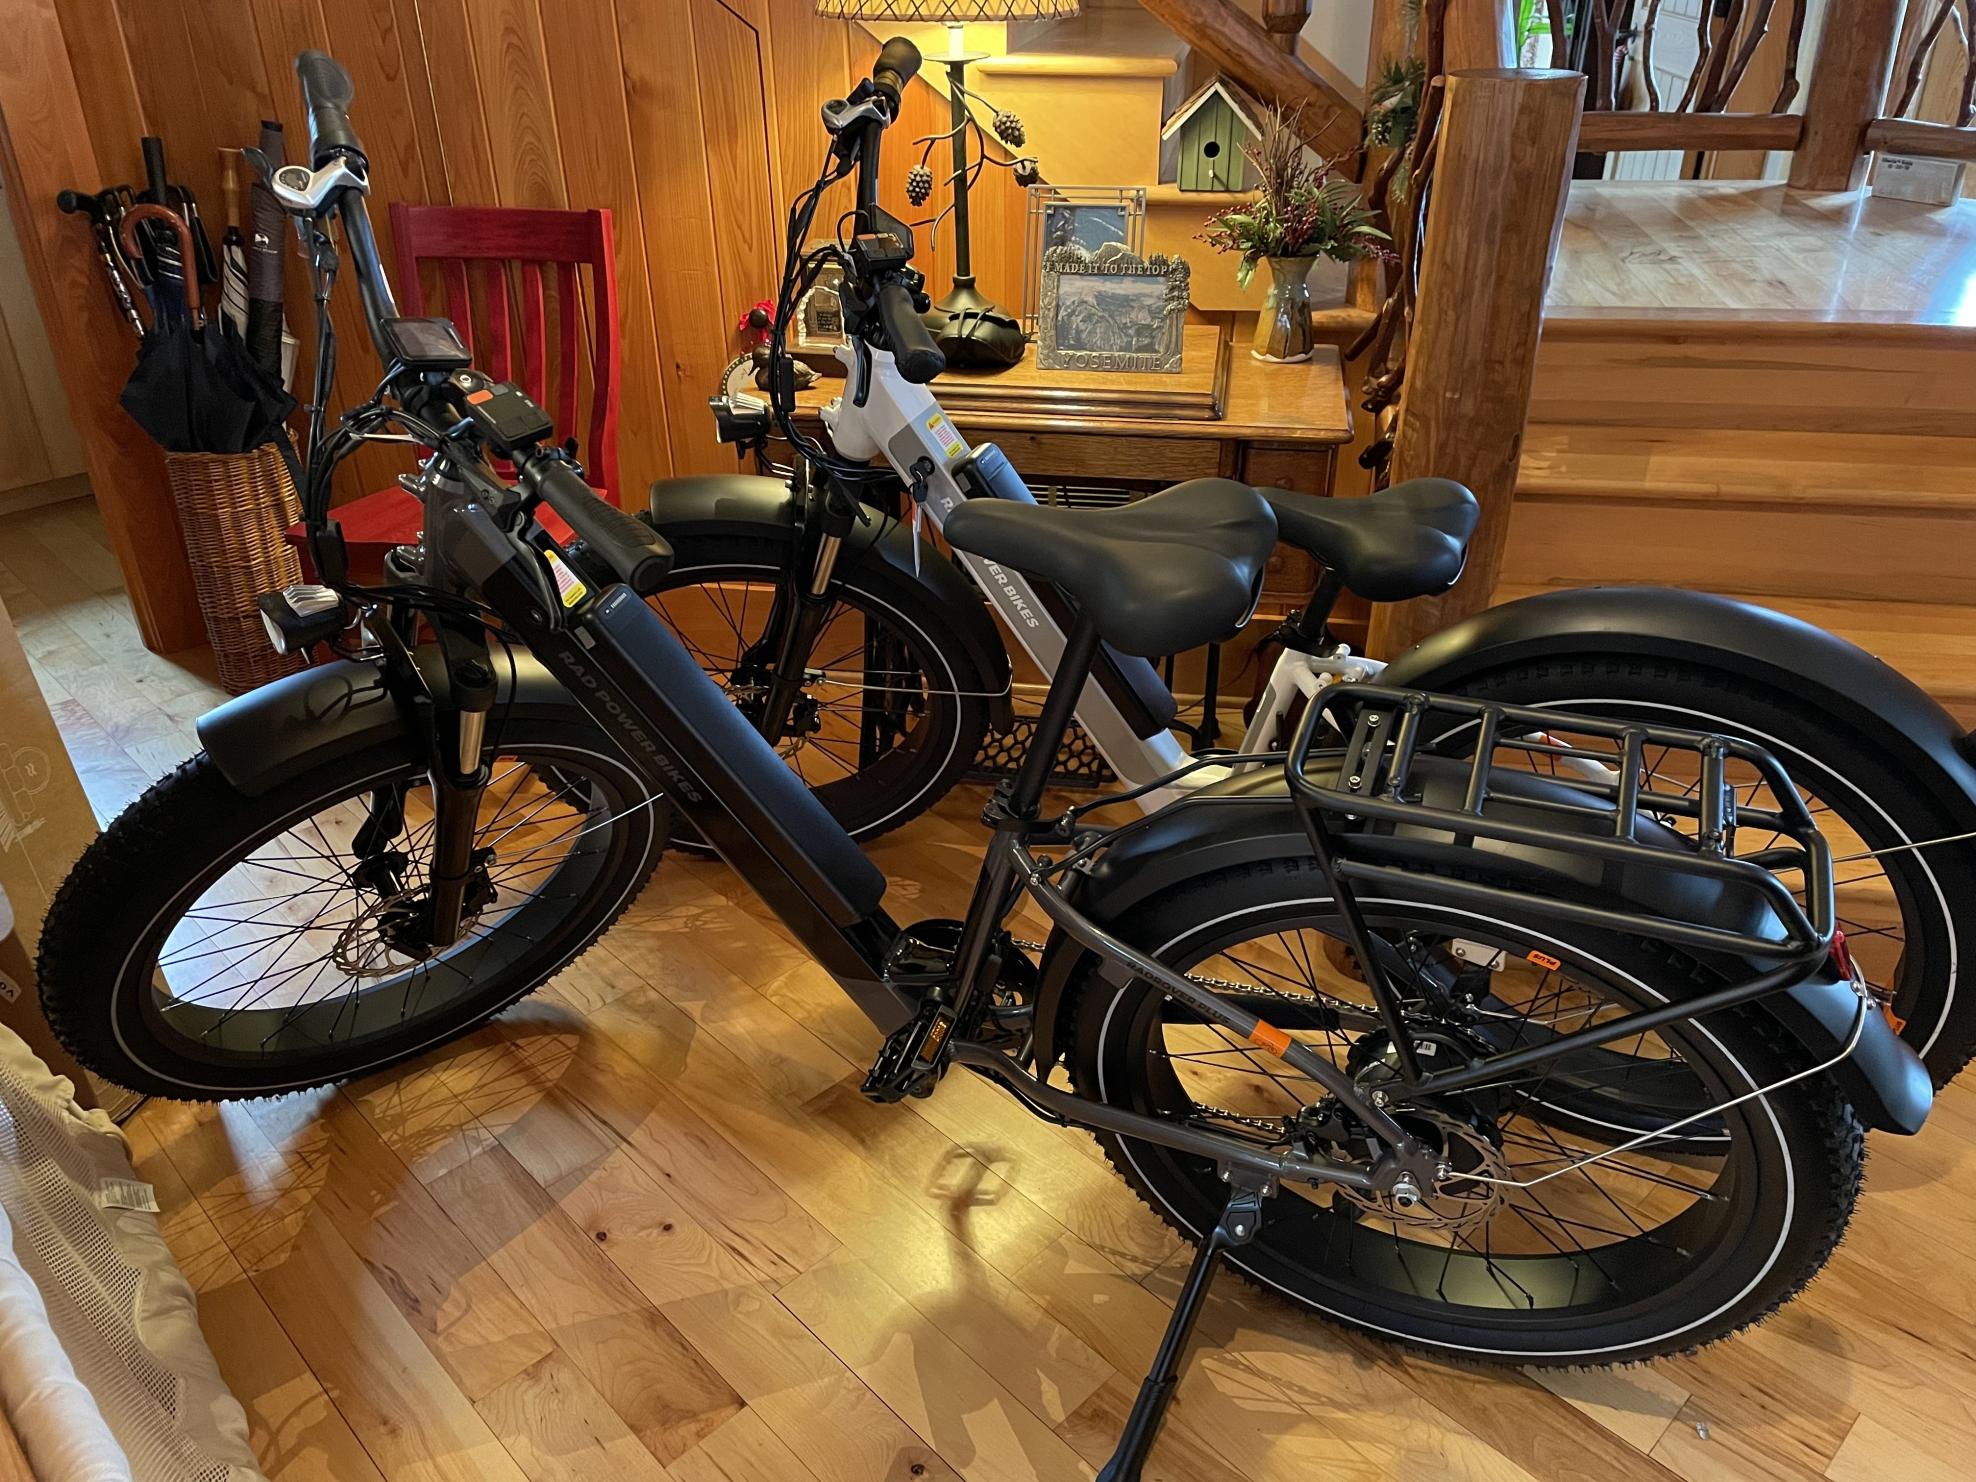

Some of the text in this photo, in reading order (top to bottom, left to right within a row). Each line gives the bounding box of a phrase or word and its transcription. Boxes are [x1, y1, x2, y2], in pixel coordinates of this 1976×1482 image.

[1054, 262, 1085, 273] MADE
[1088, 263, 1100, 273] IT
[1103, 263, 1118, 273] TO
[1120, 264, 1144, 274] THE
[1146, 264, 1168, 275] TOP
[1063, 353, 1161, 370] YOSEMITE
[1003, 585, 1039, 628] BIKES
[558, 651, 597, 688] RAD
[595, 690, 657, 752] POWER
[653, 754, 703, 803] BIKES
[1126, 961, 1231, 1025] RADROVER PLUS
